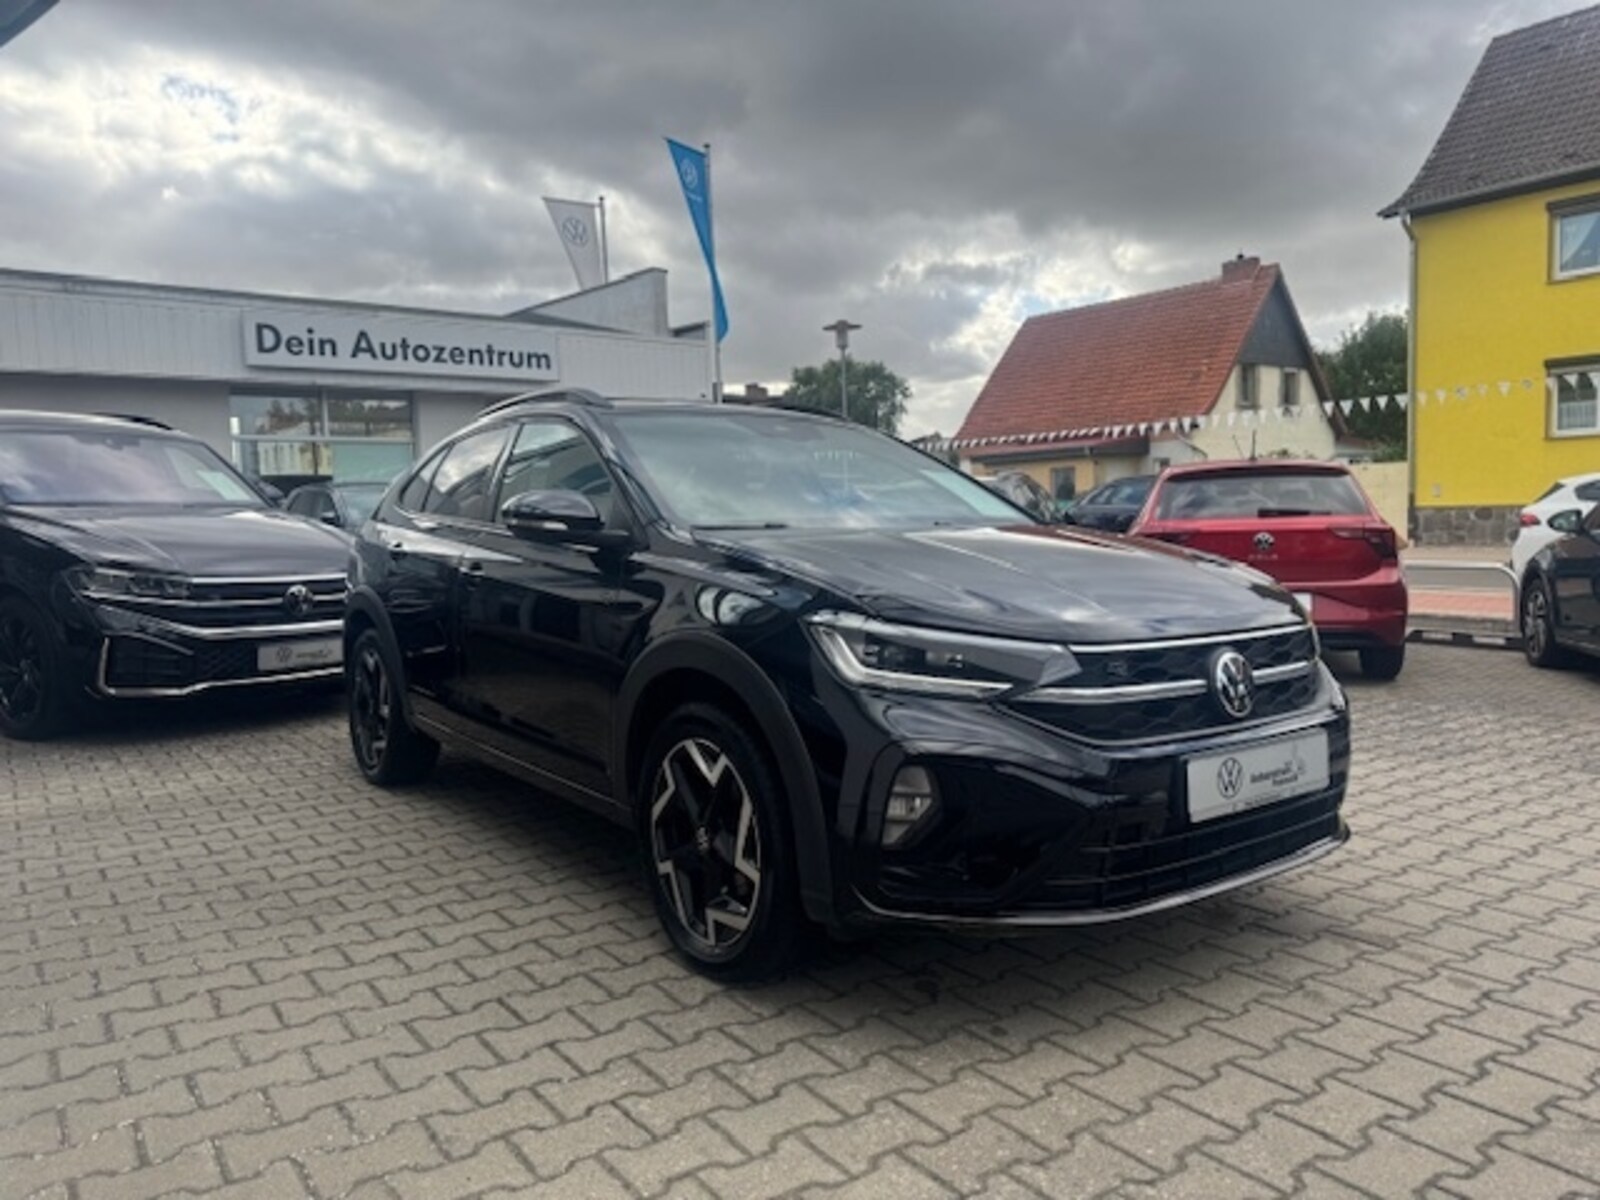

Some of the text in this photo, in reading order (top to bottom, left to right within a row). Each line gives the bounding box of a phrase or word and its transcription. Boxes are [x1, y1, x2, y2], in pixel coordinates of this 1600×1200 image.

[255, 323, 552, 370] Dein Autozentrum
[1216, 651, 1252, 717] VW
[1218, 757, 1243, 799] VW
